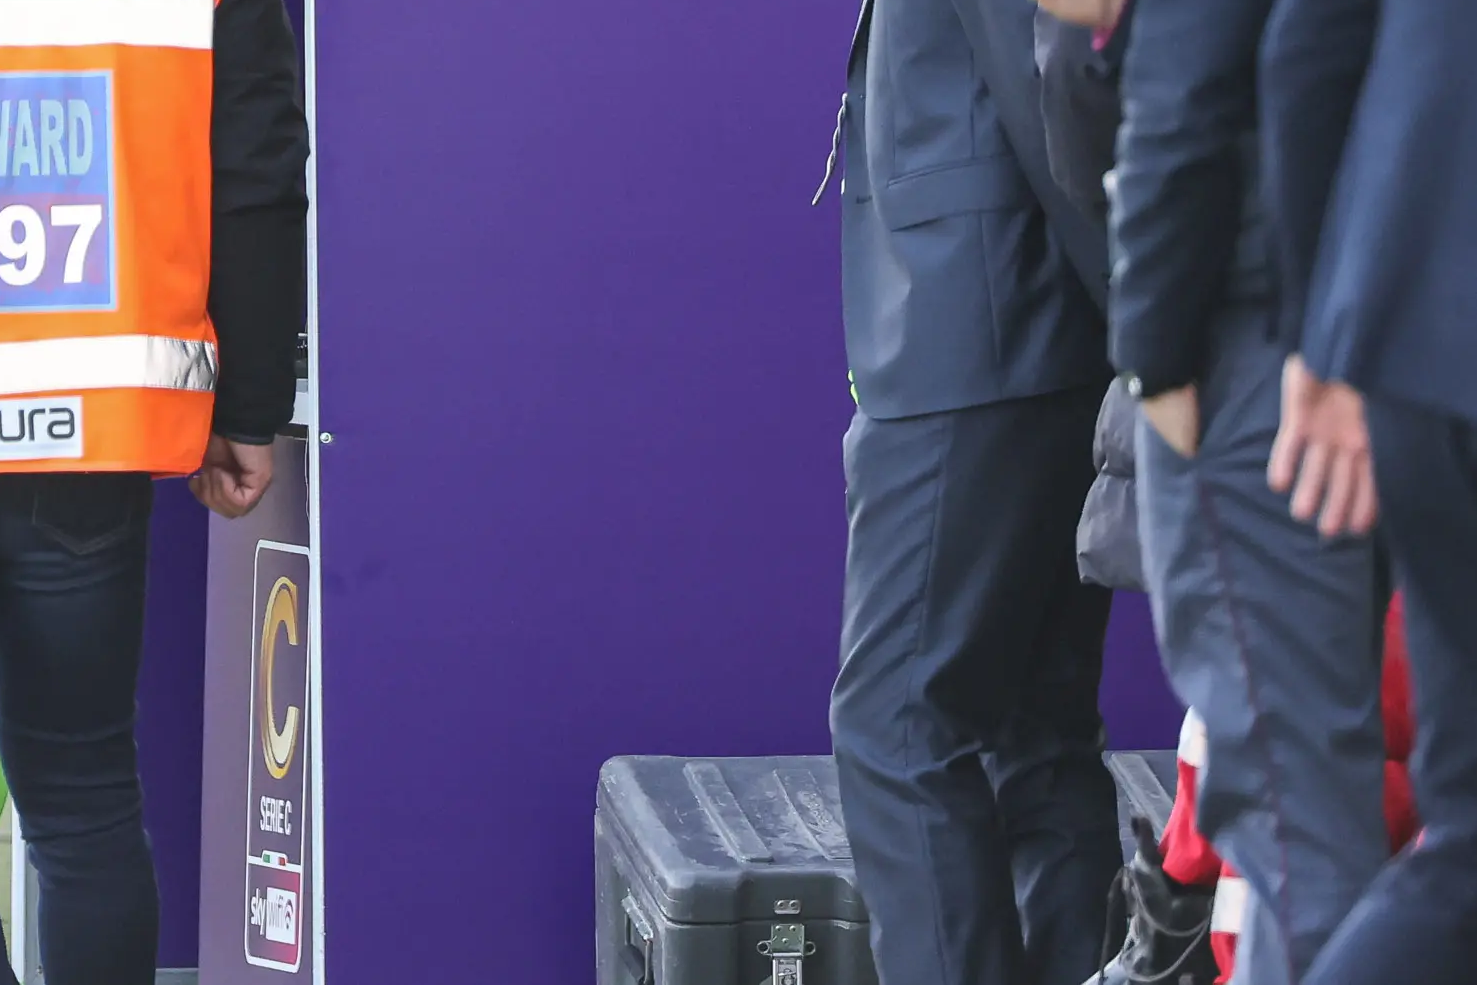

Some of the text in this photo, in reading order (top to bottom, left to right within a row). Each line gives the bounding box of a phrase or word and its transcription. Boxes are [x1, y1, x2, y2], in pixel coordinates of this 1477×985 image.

[260, 795, 292, 835] SERIE C
[250, 888, 266, 935] sky
